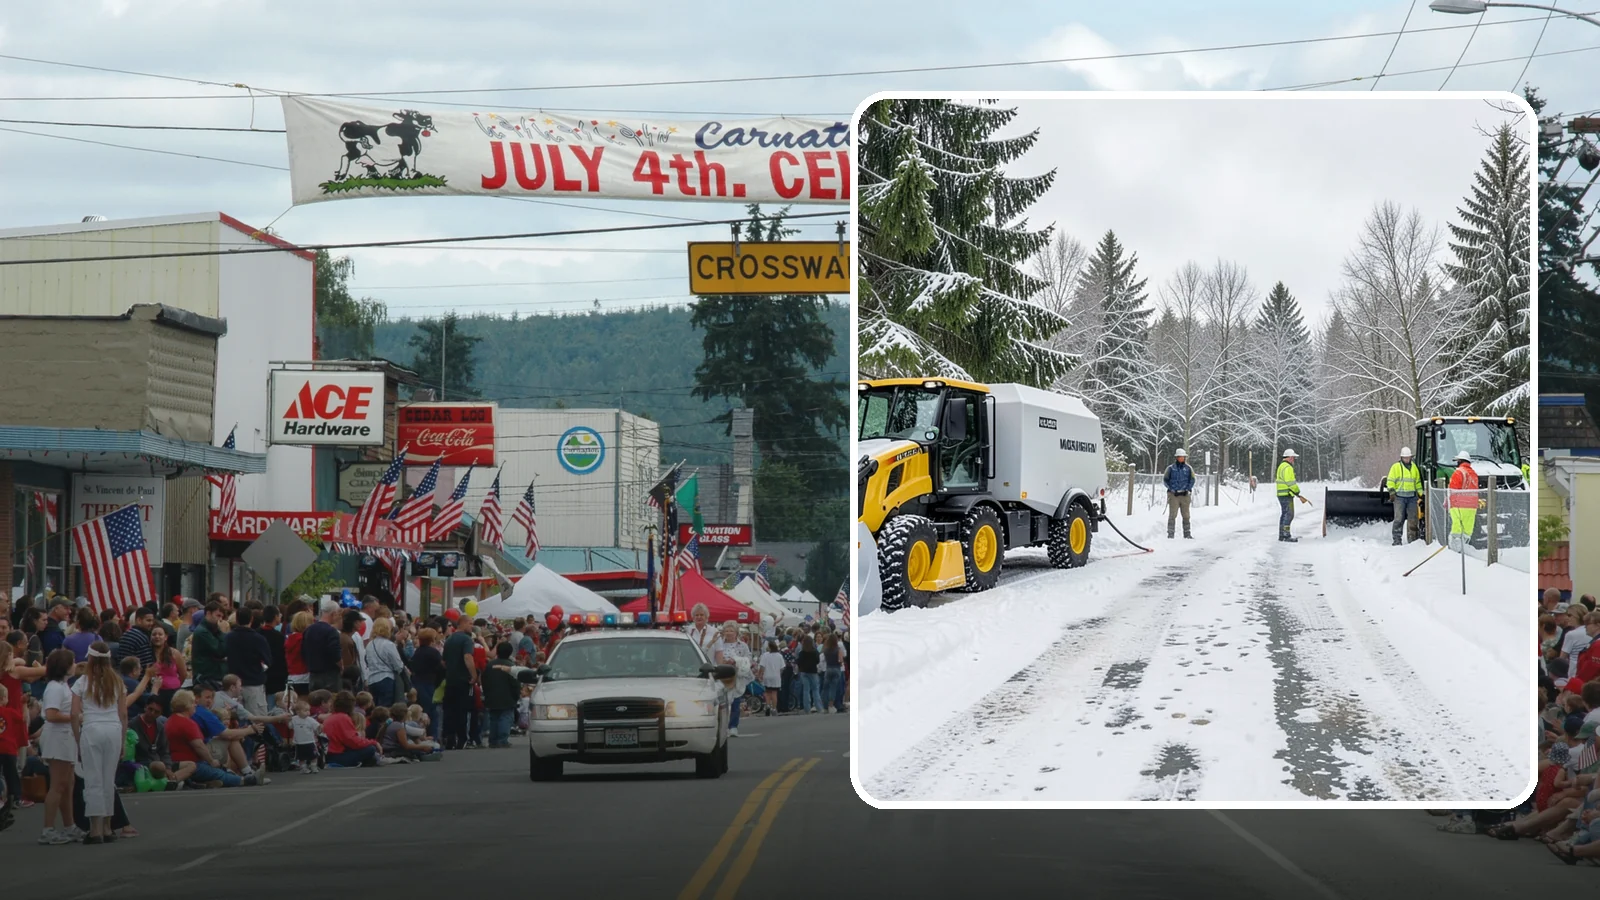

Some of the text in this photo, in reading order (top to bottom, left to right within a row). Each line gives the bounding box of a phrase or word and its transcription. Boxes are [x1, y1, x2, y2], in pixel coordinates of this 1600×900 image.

[481, 141, 605, 191] JULY
[632, 150, 746, 198] 4th.
[697, 254, 850, 280] CROSSWA
[283, 380, 373, 420] ACE
[406, 409, 485, 421] CEDAR LOG
[283, 421, 371, 437] Hardware
[416, 428, 477, 446] Coca-Cola
[353, 467, 384, 480] Simpl
[96, 485, 124, 495] Vincent
[126, 486, 136, 495] de
[137, 486, 155, 495] Paul
[81, 503, 154, 522] THT
[688, 526, 741, 535] CRNATION
[699, 535, 730, 543] GLASS
